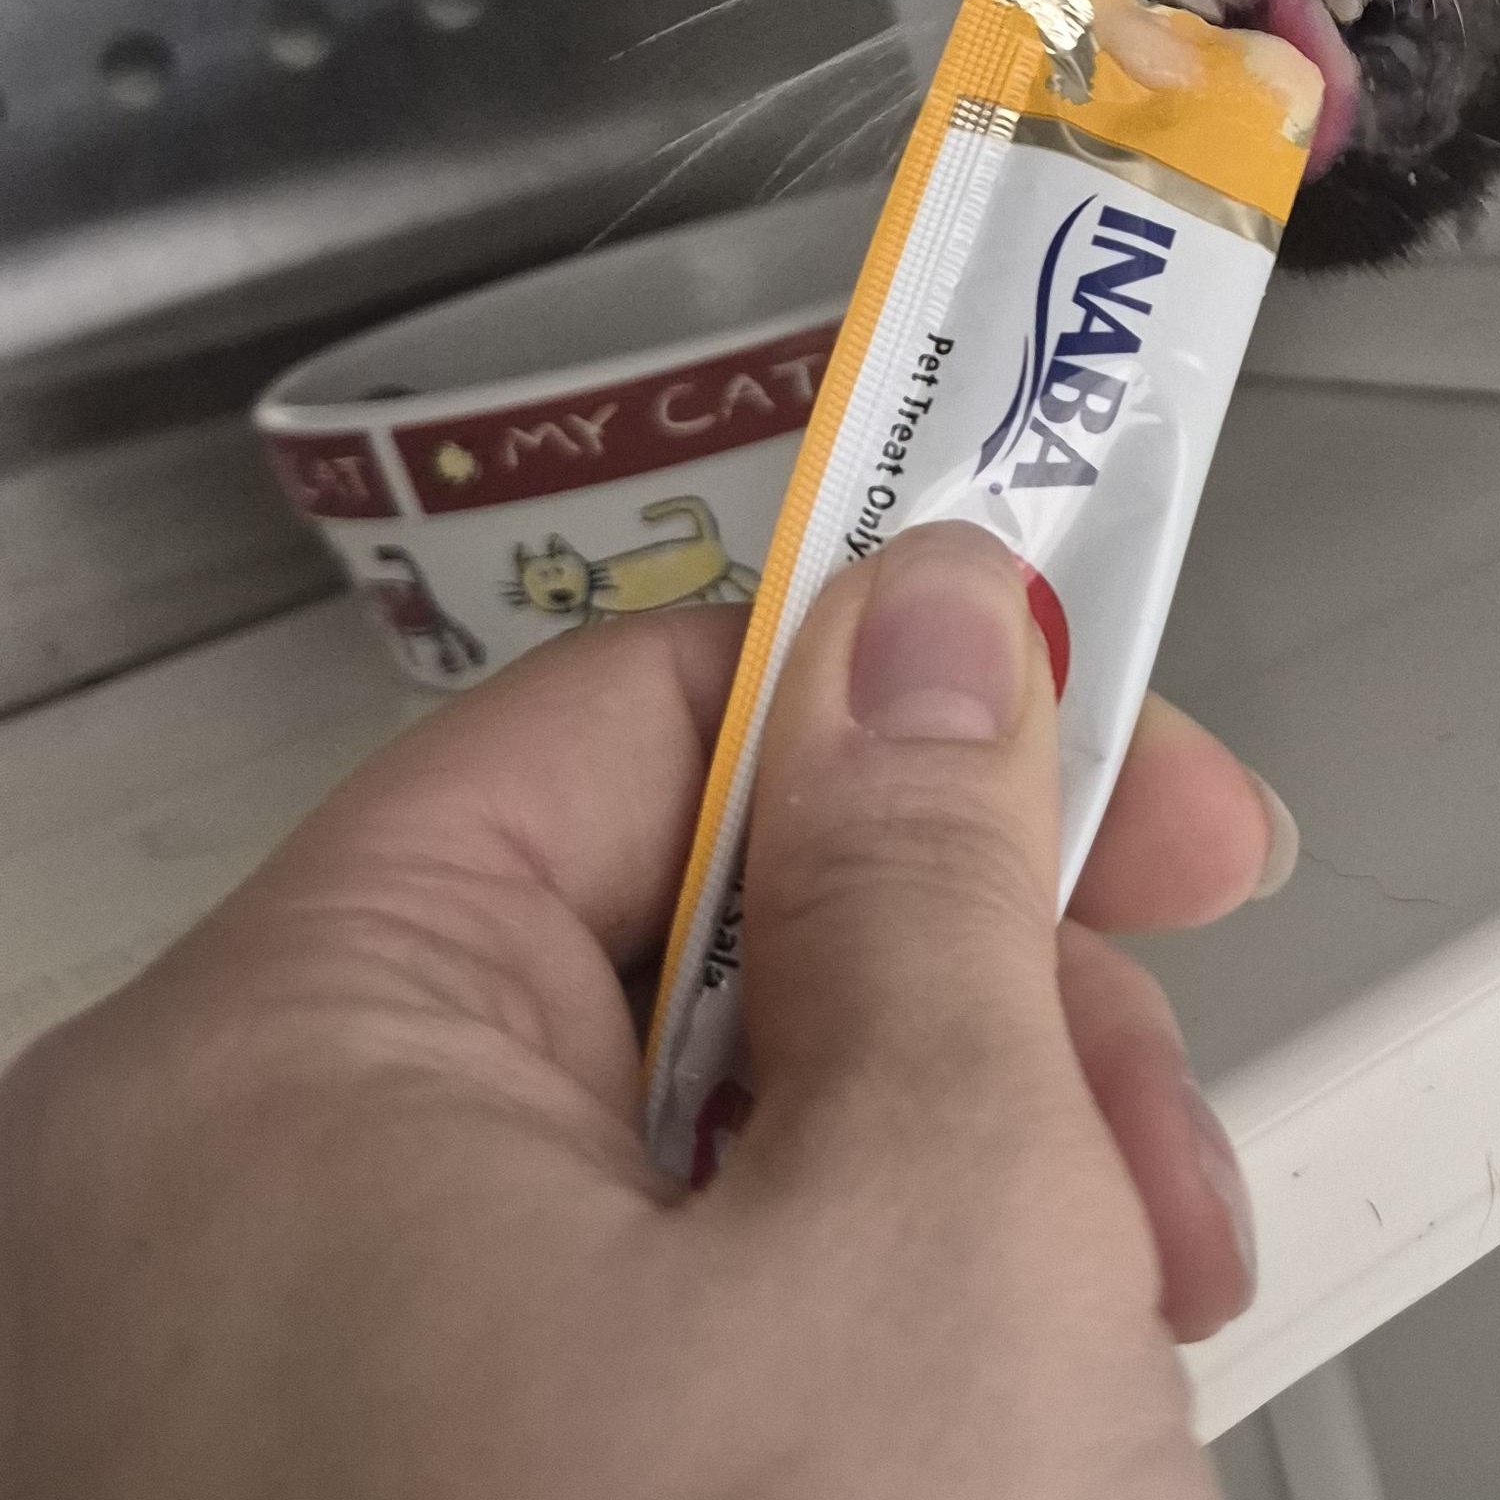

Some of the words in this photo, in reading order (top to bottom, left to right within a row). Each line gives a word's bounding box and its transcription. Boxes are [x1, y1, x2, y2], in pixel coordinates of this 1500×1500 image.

[911, 332, 955, 387] Pet
[1009, 205, 1177, 489] INABA
[501, 402, 620, 470] MY
[655, 353, 827, 437] CAT
[876, 396, 934, 477] Treat
